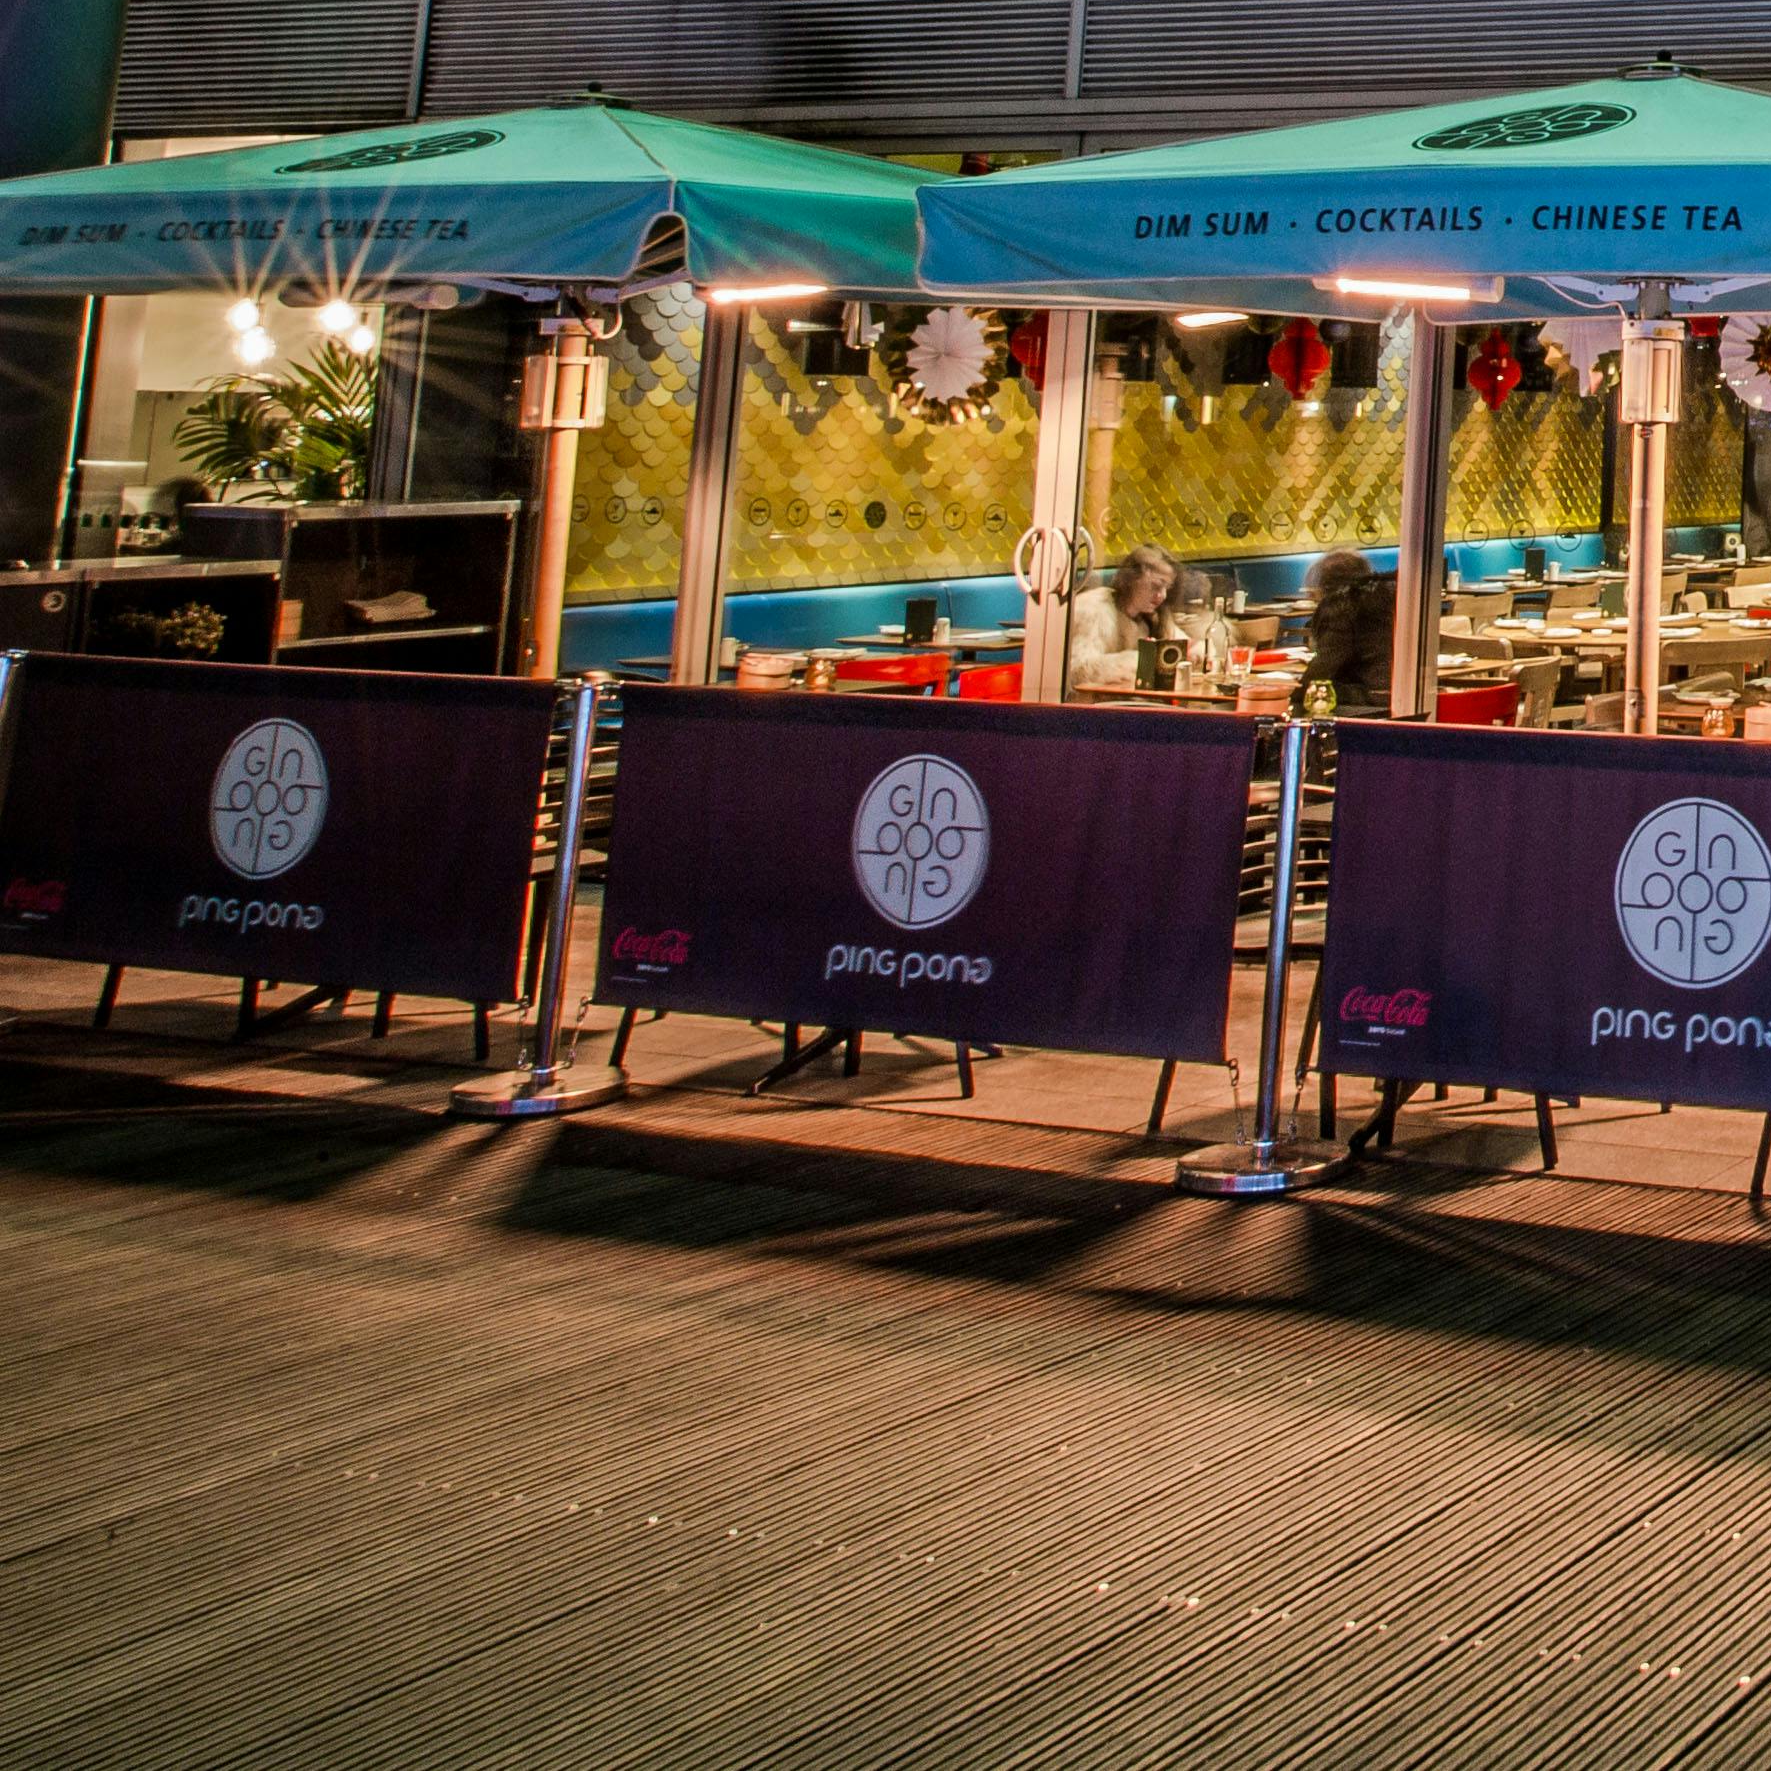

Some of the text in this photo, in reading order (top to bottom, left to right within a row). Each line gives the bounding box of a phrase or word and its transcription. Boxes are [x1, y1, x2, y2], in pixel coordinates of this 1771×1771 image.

[19, 218, 469, 245] DIM SUM COCKTAILS CHINESE TEA
[1135, 205, 1743, 239] DIM SUM COCKTAILS CHINESE TEA
